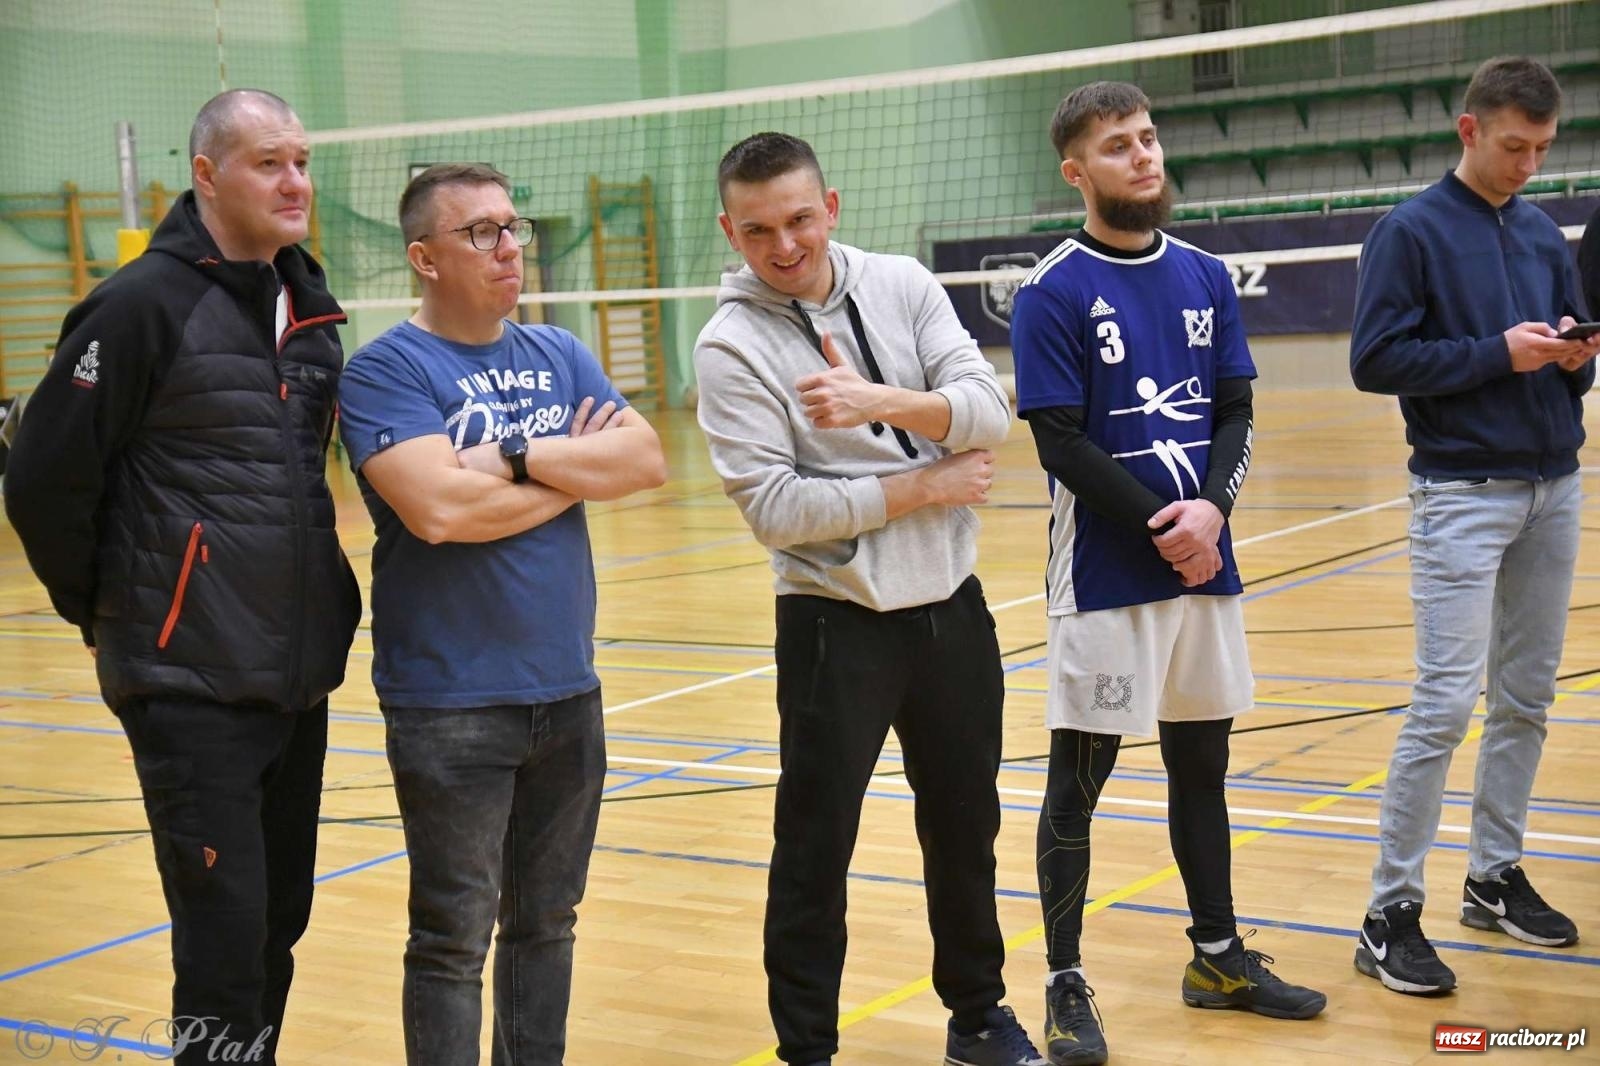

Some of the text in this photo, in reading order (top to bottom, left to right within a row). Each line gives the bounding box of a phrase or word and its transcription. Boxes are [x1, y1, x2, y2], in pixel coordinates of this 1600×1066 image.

[1089, 306, 1116, 318] adidas
[1096, 320, 1126, 365] 3
[456, 368, 552, 397] VINTAGE
[519, 397, 533, 408] BY
